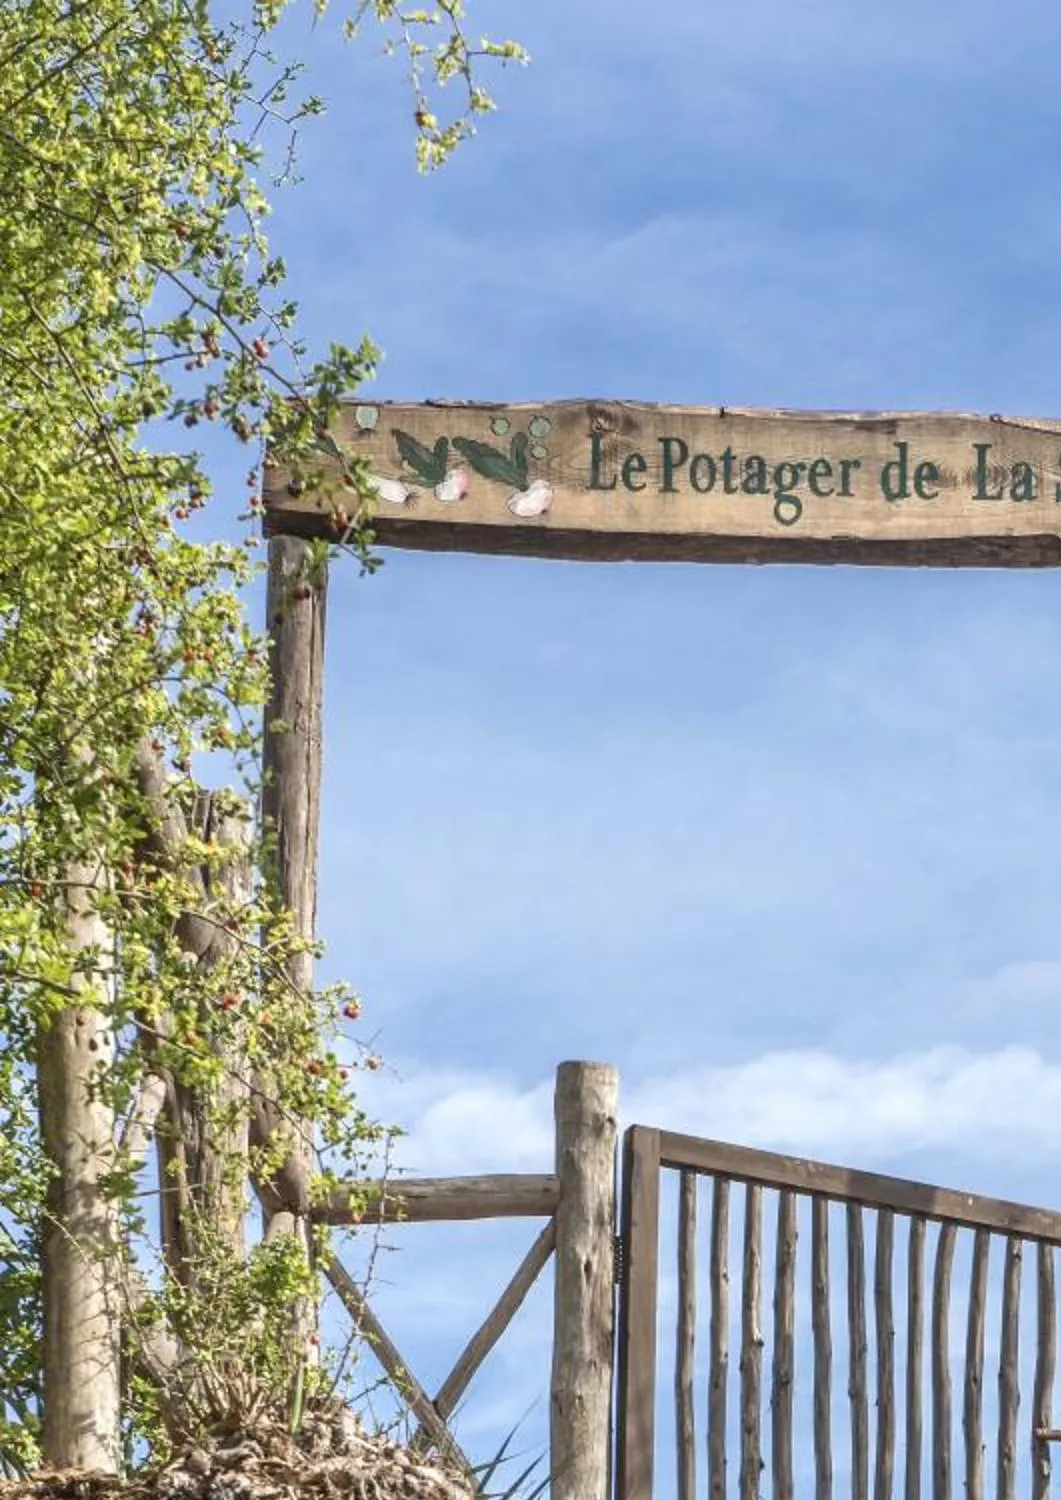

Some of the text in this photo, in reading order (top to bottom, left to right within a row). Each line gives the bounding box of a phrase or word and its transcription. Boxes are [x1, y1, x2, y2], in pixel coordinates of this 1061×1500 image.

[586, 431, 648, 493] Le
[657, 436, 862, 527] Potager
[880, 441, 940, 502] de
[971, 442, 1038, 502] La
